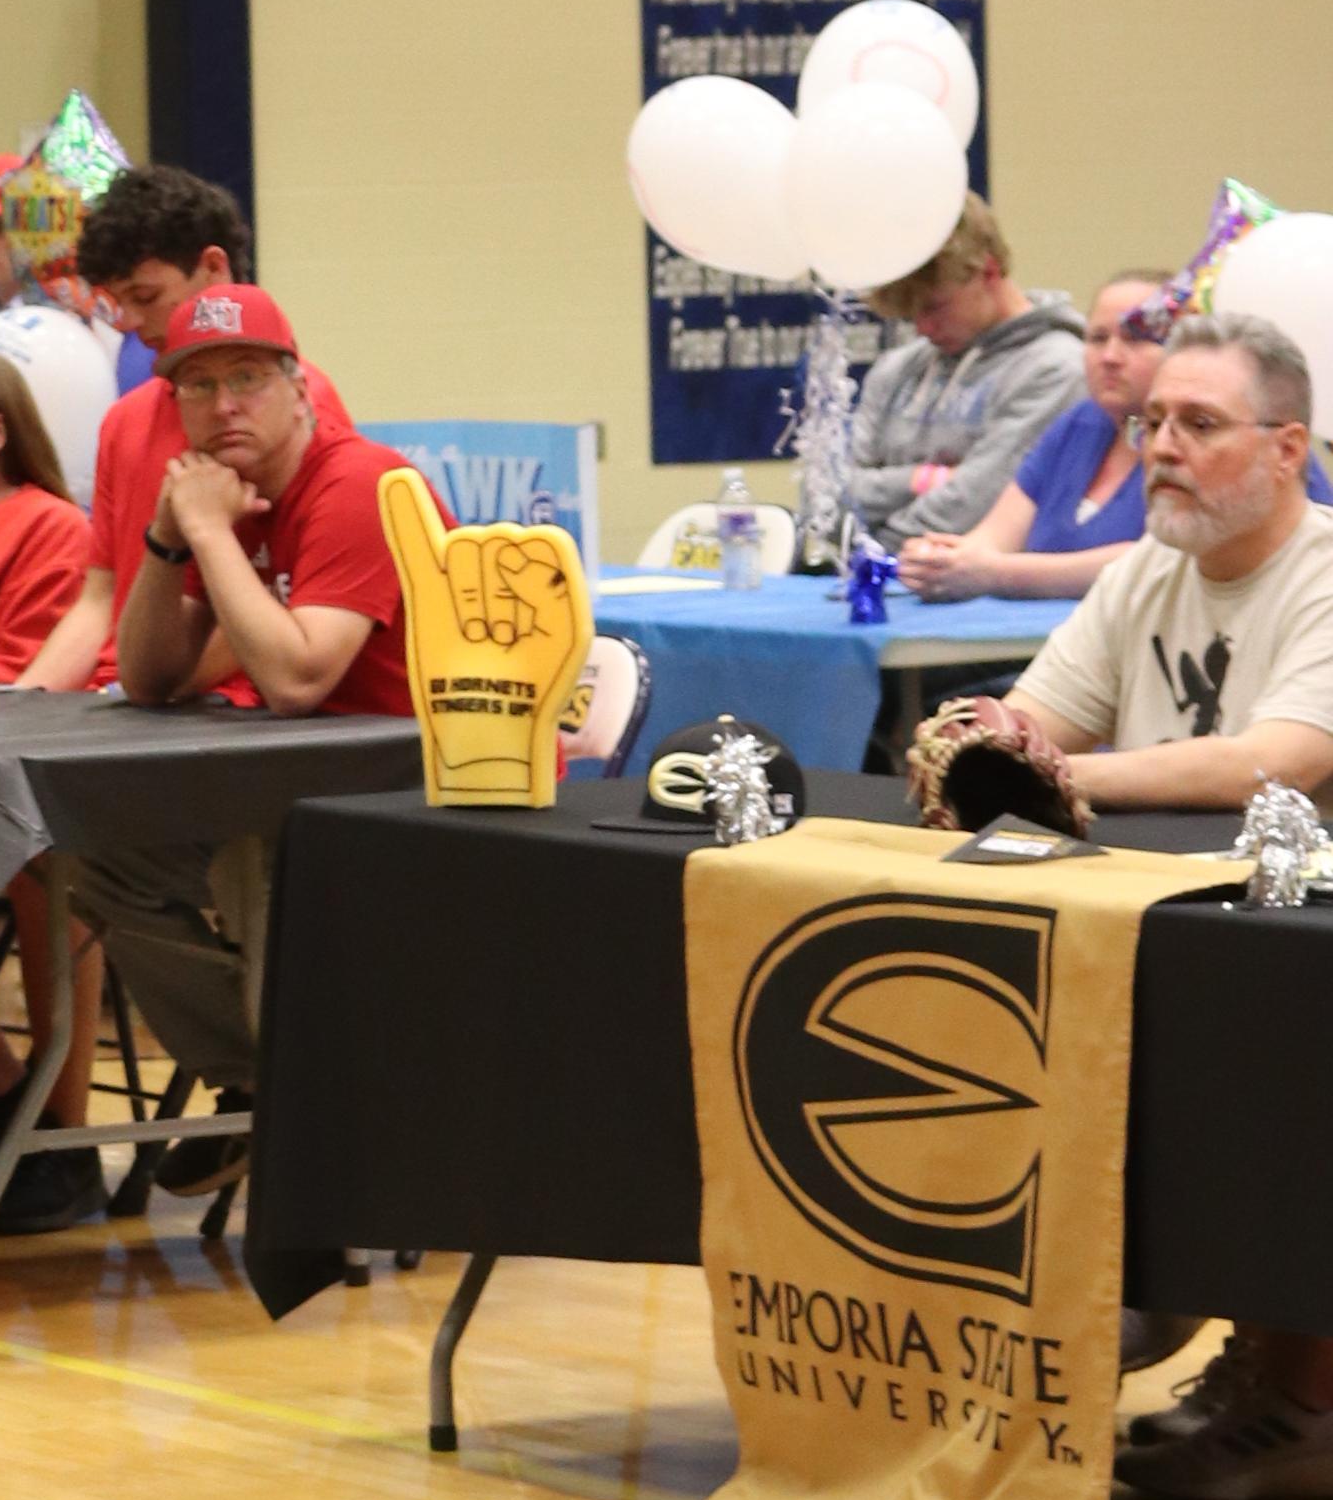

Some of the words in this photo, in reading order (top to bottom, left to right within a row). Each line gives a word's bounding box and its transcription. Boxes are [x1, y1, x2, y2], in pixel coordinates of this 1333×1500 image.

[451, 677, 536, 699] HORNETS
[729, 1270, 942, 1374] EMPORIA
[957, 1315, 1069, 1405] STATE
